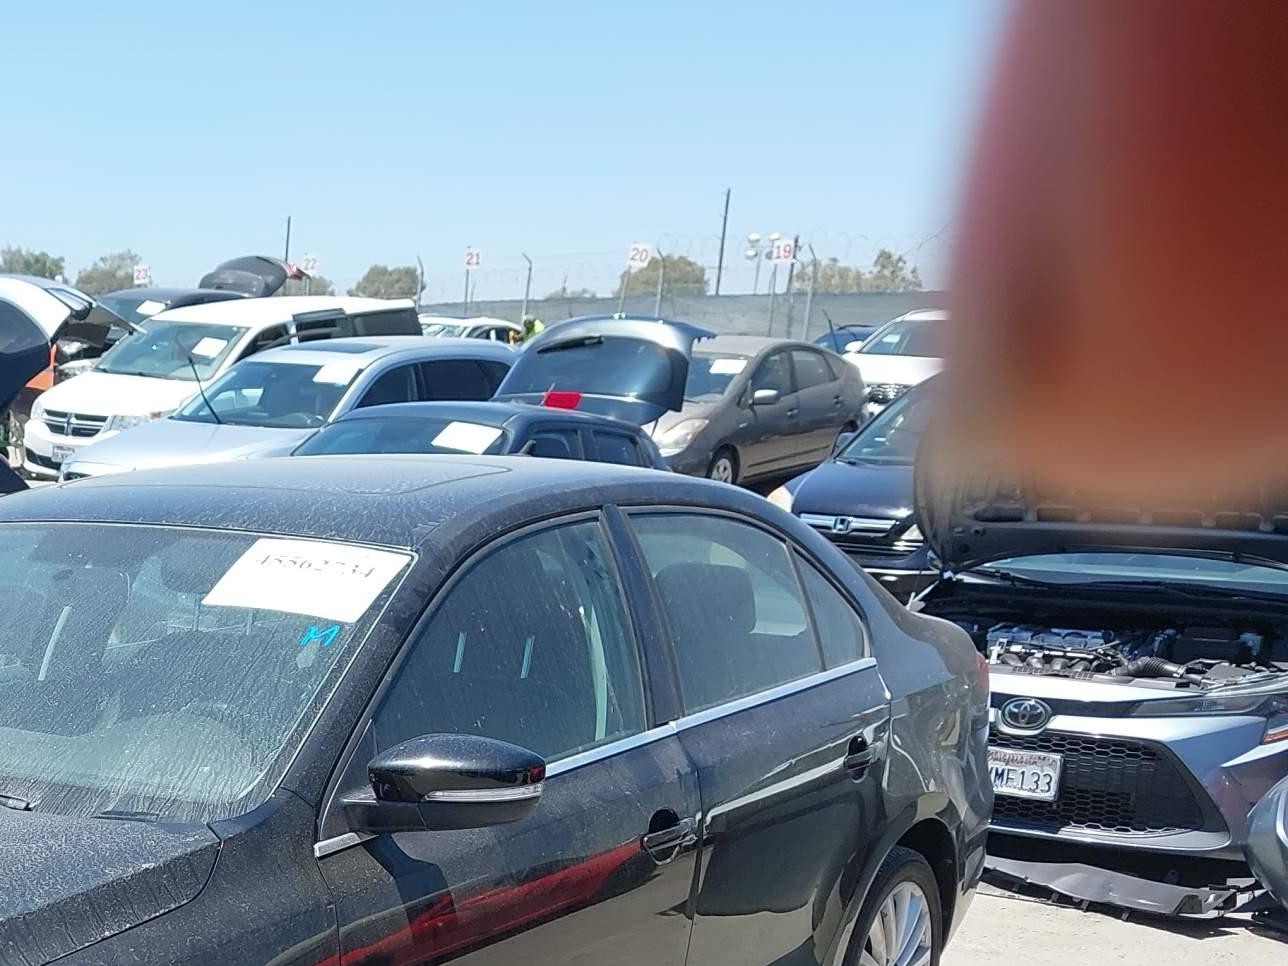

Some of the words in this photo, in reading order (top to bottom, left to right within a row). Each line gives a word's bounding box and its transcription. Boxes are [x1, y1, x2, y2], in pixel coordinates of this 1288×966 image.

[466, 252, 480, 265] 21
[630, 247, 649, 262] 20
[775, 244, 792, 260] 19
[304, 257, 317, 270] 22
[136, 268, 148, 280] 23
